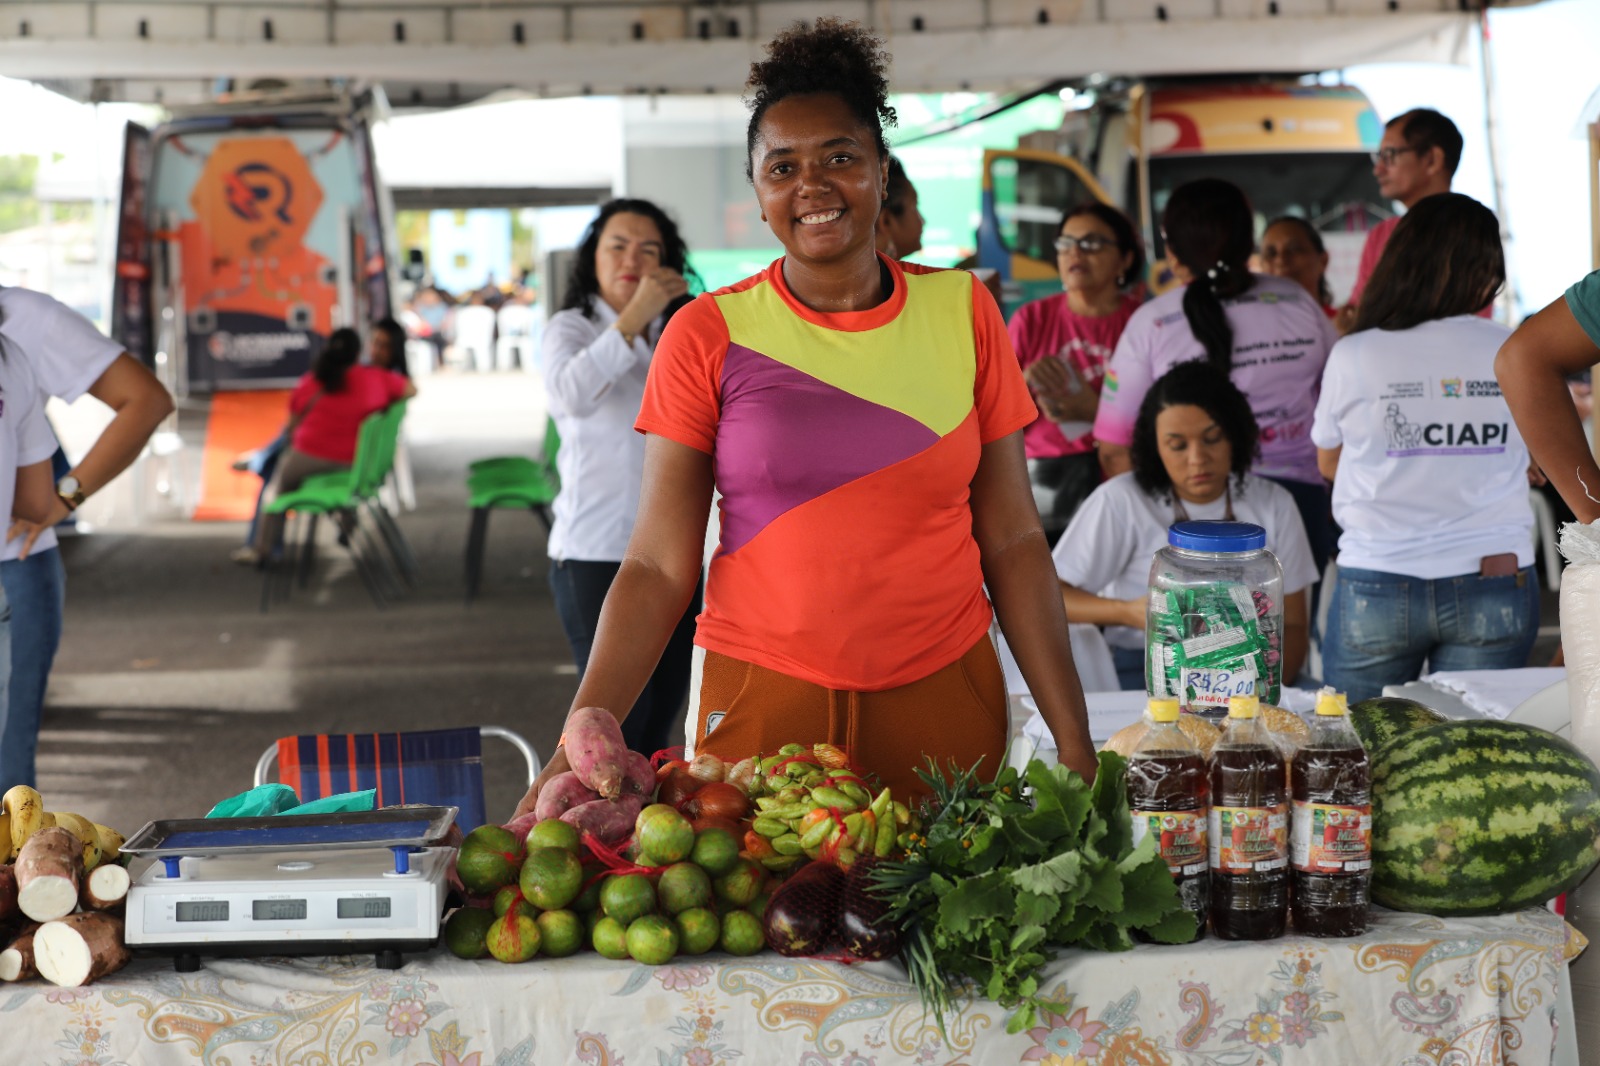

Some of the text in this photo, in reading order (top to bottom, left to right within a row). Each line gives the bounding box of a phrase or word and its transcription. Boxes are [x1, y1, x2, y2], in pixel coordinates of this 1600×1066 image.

[1465, 380, 1500, 390] GOVERN
[1423, 423, 1508, 446] CIAPI
[1195, 696, 1230, 704] NIDADE
